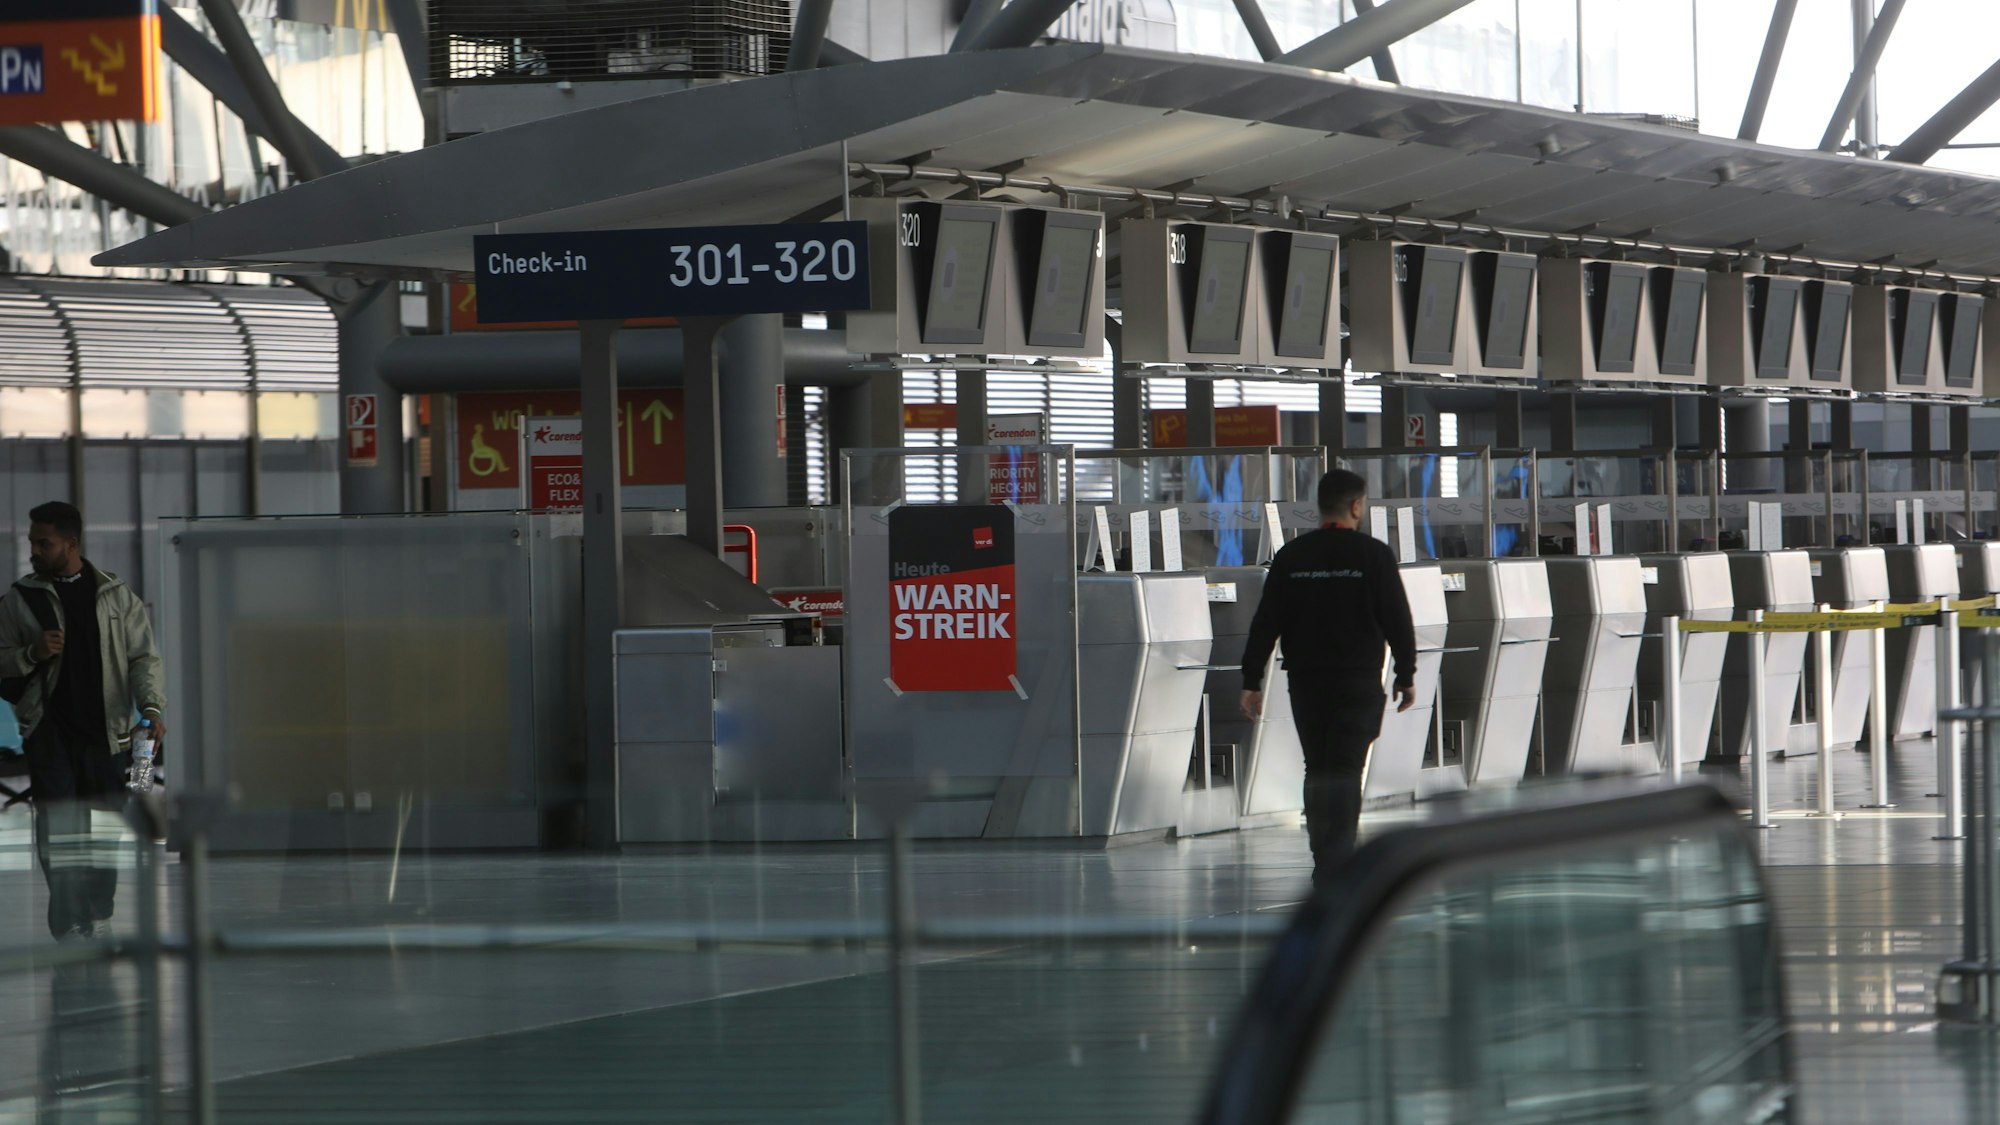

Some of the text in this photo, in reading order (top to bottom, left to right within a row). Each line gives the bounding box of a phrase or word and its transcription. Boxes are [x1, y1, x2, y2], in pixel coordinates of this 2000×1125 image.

[901, 213, 920, 247] 320
[1170, 232, 1186, 264] 318
[488, 238, 856, 287] Check-in 301-320
[549, 431, 582, 441] corend
[994, 428, 1036, 438] corendon
[547, 473, 581, 485] ECO&
[989, 467, 1036, 479] RIORITY
[989, 482, 1036, 494] HECK-IN
[550, 489, 579, 501] FLEX
[894, 562, 950, 577] Heute
[894, 583, 1011, 610] WARN-
[803, 600, 844, 610] corendo
[894, 613, 1011, 640] STREIK
